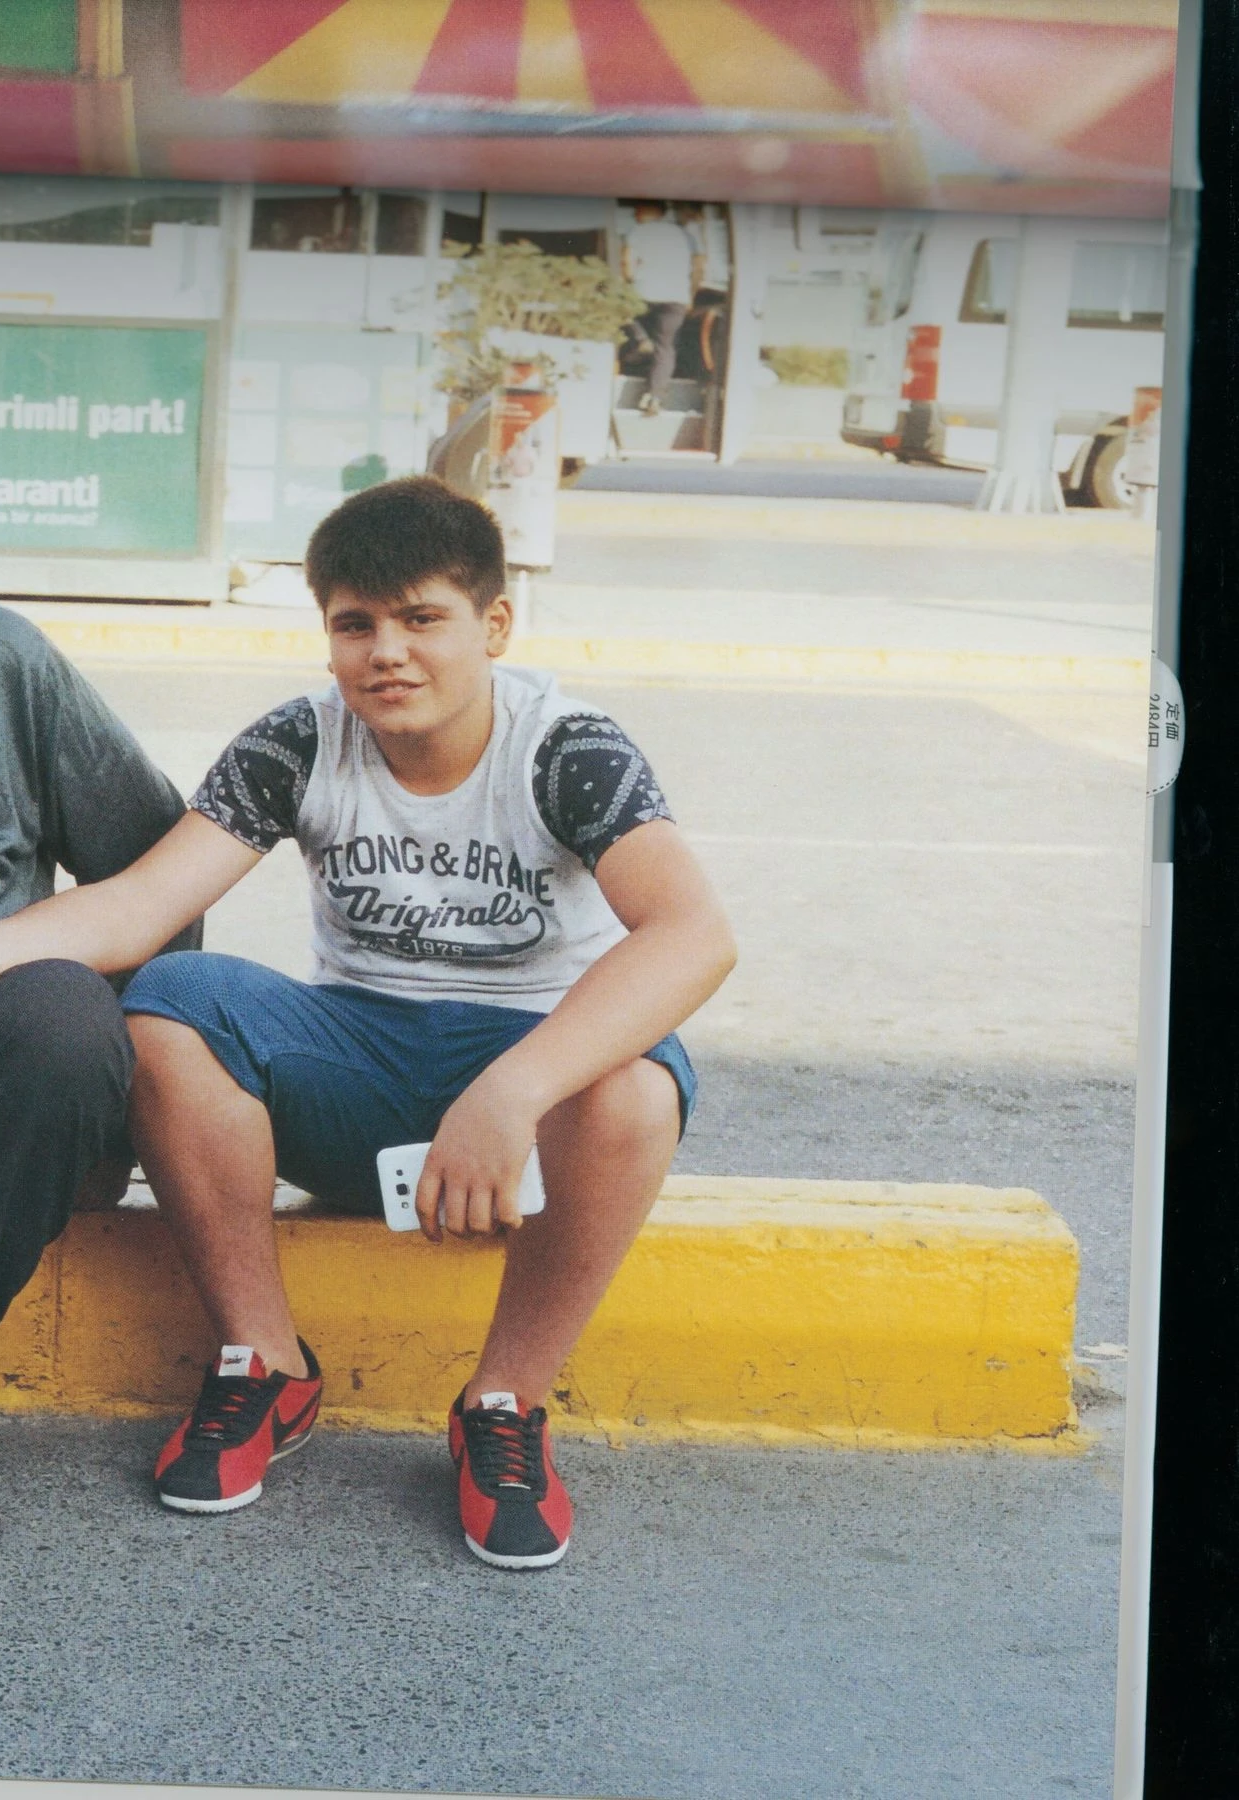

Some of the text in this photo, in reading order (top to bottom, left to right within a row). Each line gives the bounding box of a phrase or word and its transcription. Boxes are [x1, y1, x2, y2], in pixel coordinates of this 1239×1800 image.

[88, 398, 186, 440] park!
[1165, 700, 1181, 741] 定価
[430, 841, 459, 877] &
[330, 879, 530, 938] Originals
